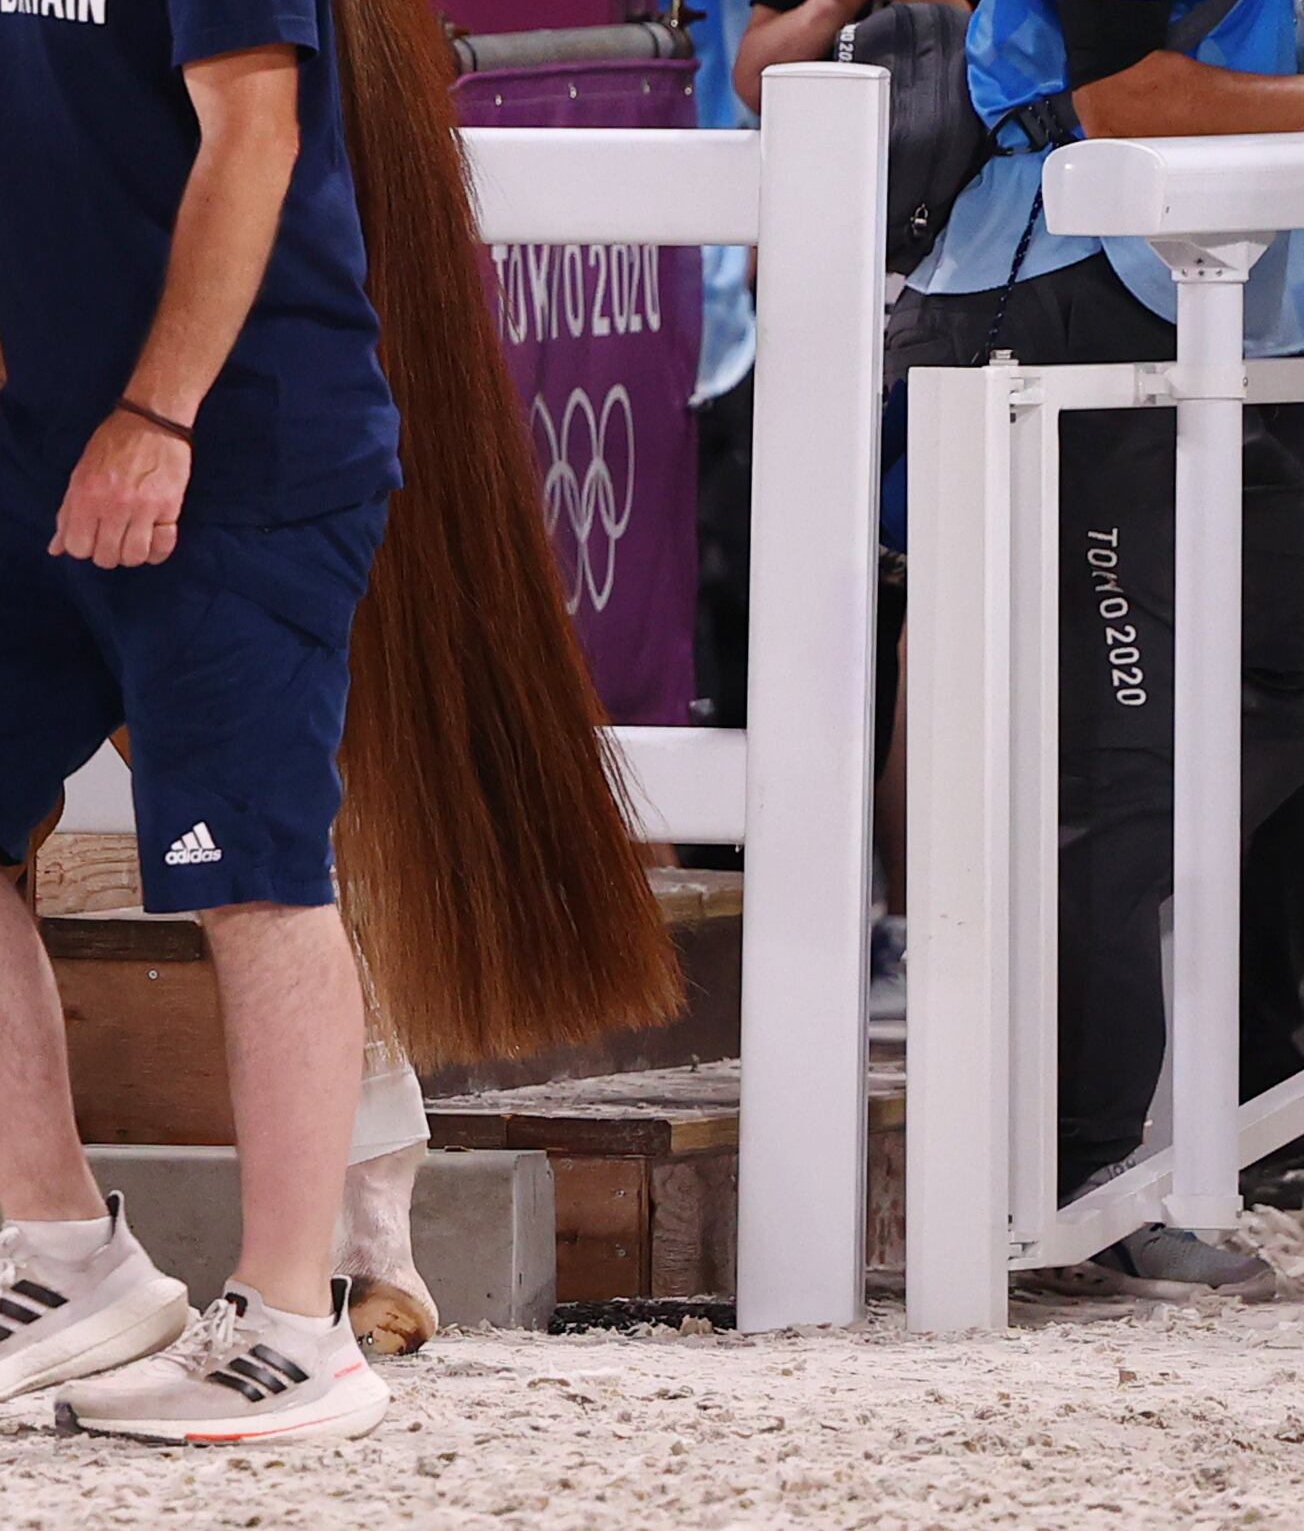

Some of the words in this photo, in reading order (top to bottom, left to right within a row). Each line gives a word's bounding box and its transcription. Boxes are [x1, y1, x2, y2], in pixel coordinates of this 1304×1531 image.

[589, 245, 661, 337] 2020
[1105, 624, 1148, 707] 2020
[164, 848, 223, 866] adidas
